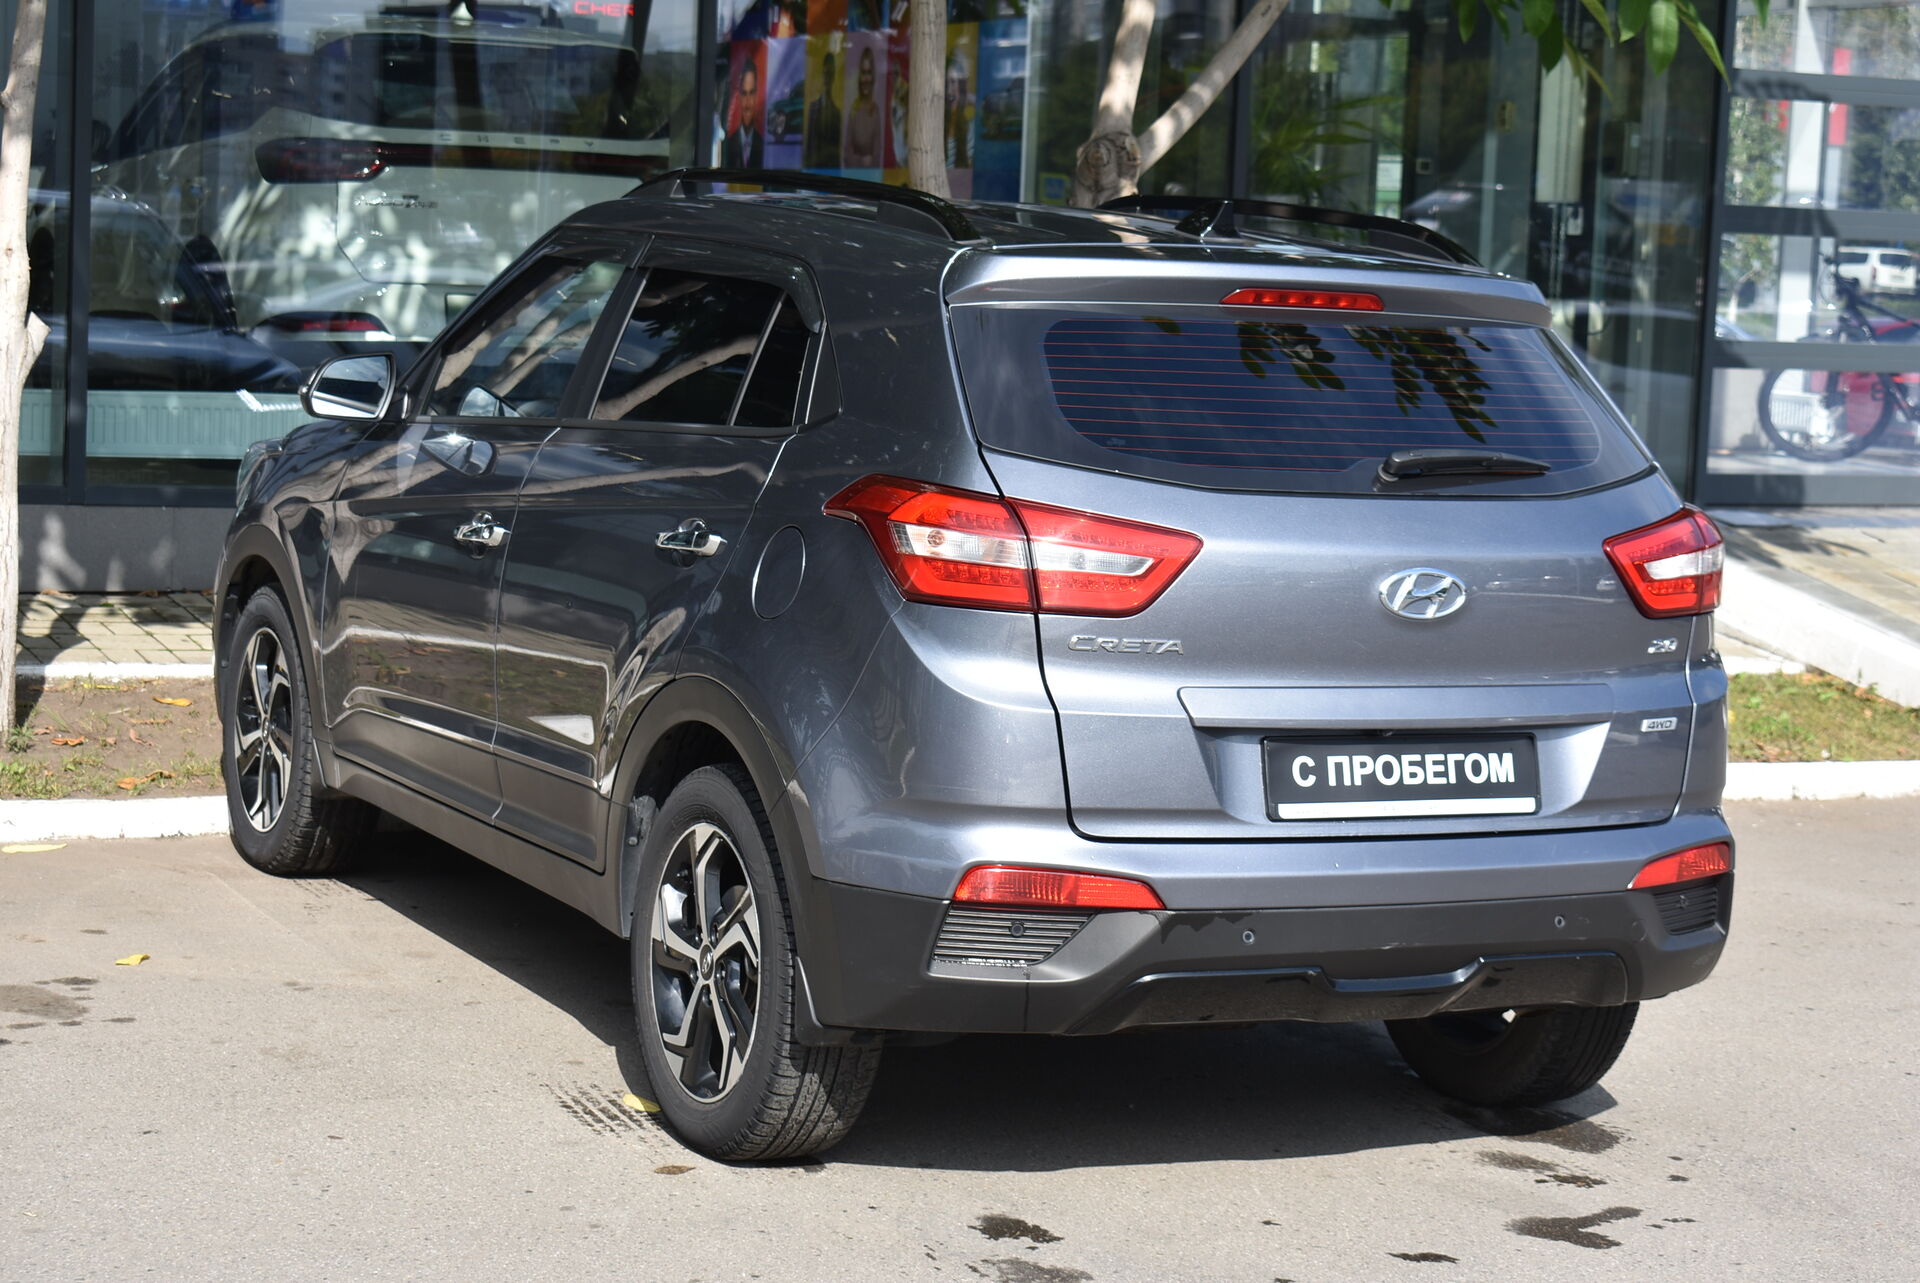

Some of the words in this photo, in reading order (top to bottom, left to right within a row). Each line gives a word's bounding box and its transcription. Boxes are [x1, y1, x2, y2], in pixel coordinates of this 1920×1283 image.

[1067, 634, 1184, 655] CRETA
[1647, 719, 1673, 730] 4WD
[1291, 755, 1316, 787] С
[1326, 752, 1515, 786] ПРОБЕГОМ
